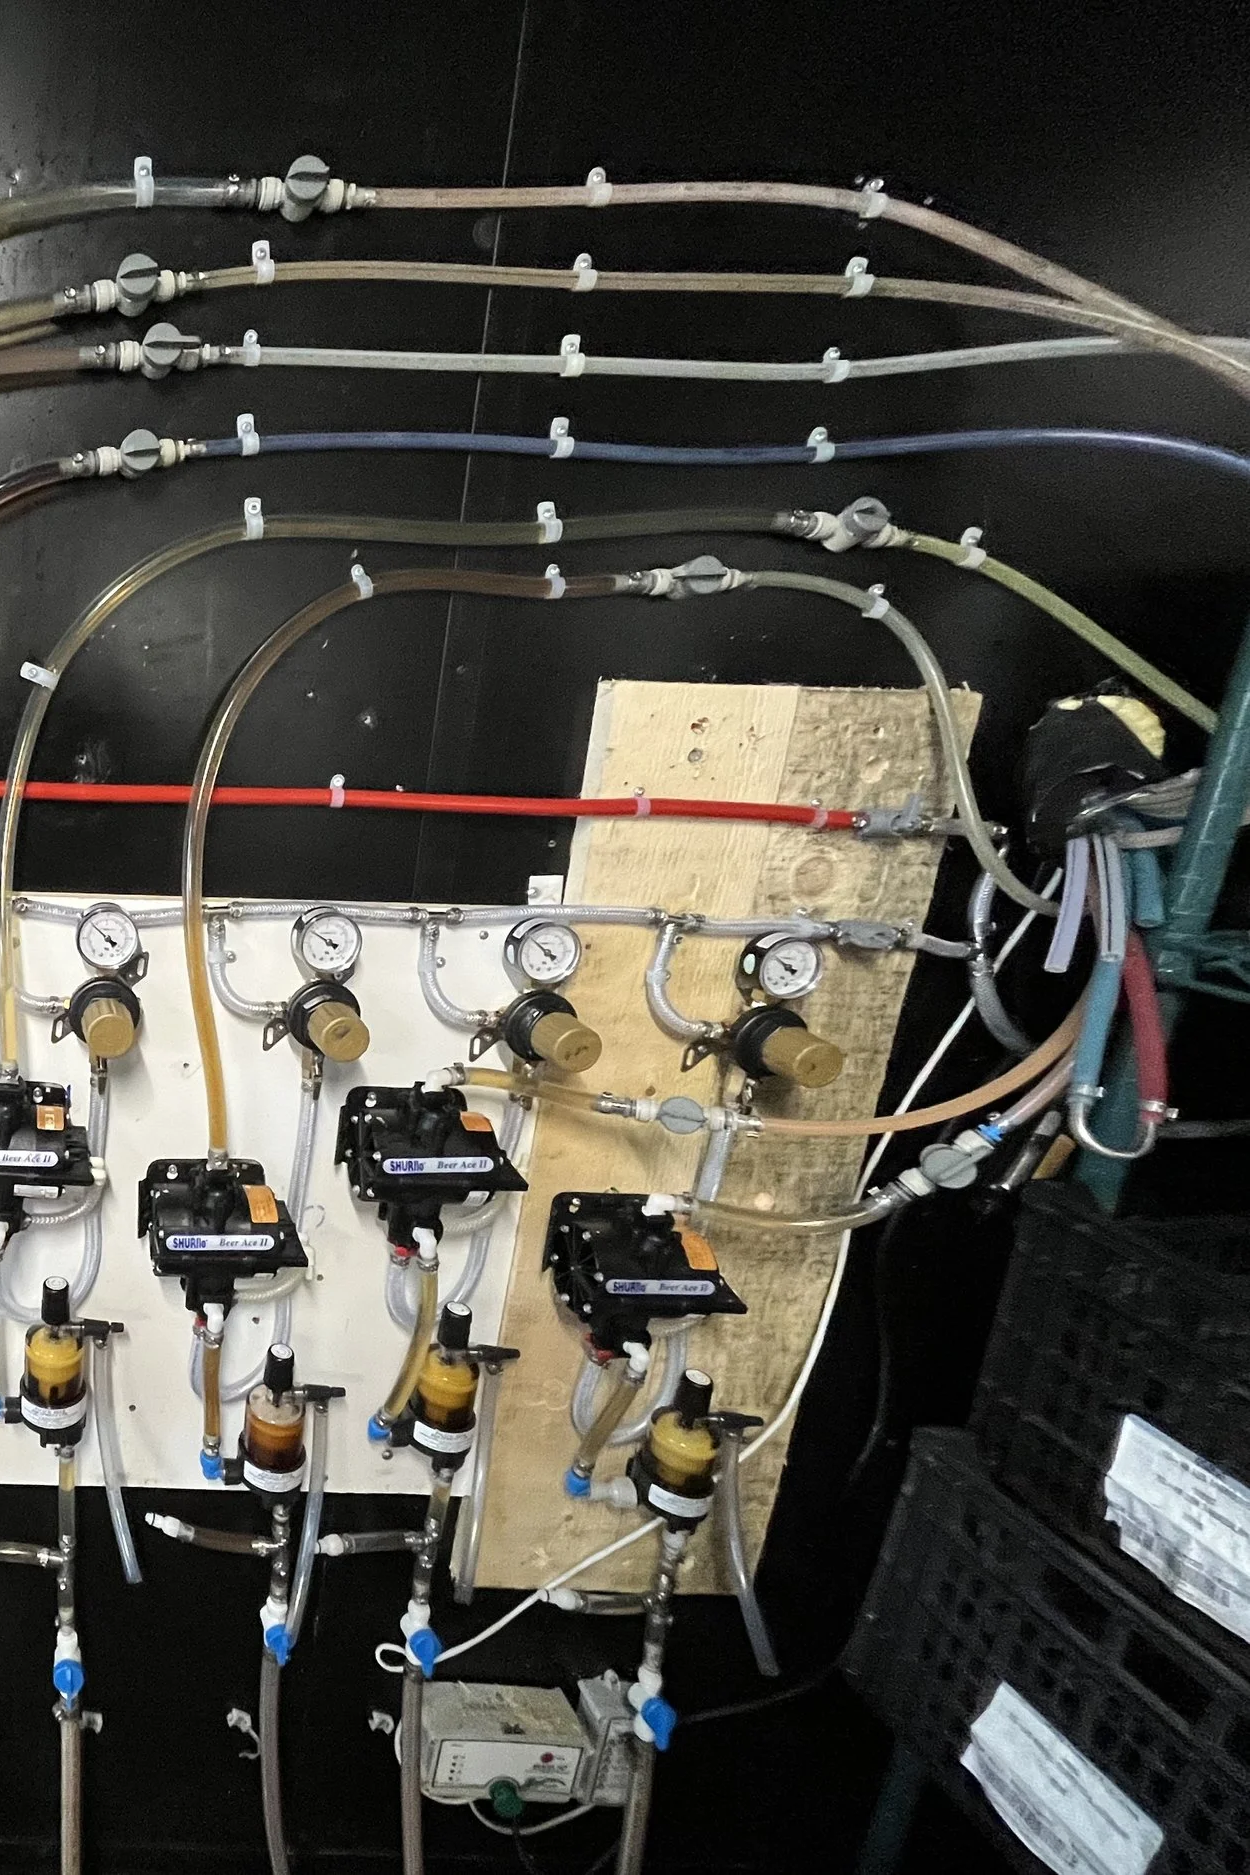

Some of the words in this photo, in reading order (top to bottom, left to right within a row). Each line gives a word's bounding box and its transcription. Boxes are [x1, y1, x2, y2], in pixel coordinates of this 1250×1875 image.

[2, 1154, 21, 1162] Beer
[24, 1154, 41, 1162] Ace
[437, 1161, 457, 1169] Beer
[460, 1160, 476, 1168] Ace
[479, 1160, 487, 1168] II
[220, 1238, 239, 1246] Beer
[260, 1238, 268, 1246] II
